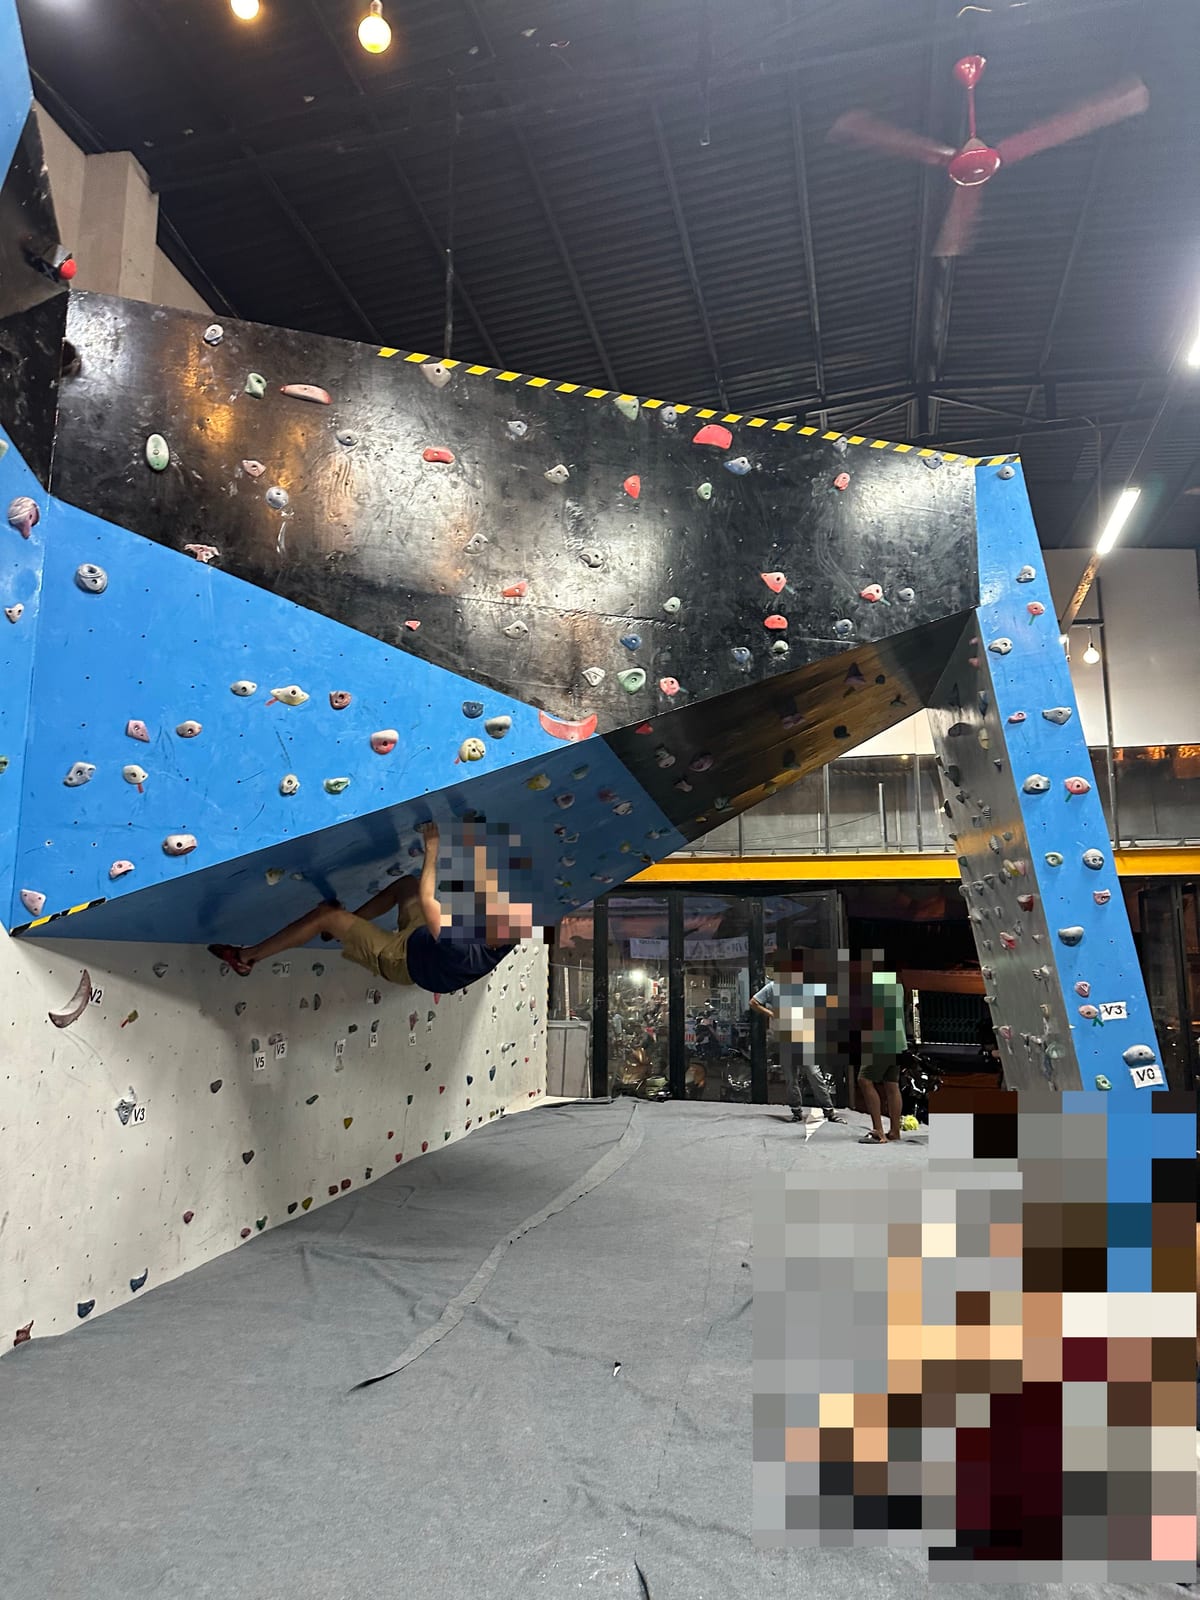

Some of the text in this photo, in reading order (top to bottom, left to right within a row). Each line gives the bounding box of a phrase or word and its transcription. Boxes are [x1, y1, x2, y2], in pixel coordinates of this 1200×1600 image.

[90, 987, 103, 1004] V2
[1104, 1005, 1123, 1016] V3
[255, 1056, 265, 1069] V5
[134, 1107, 145, 1122] V3
